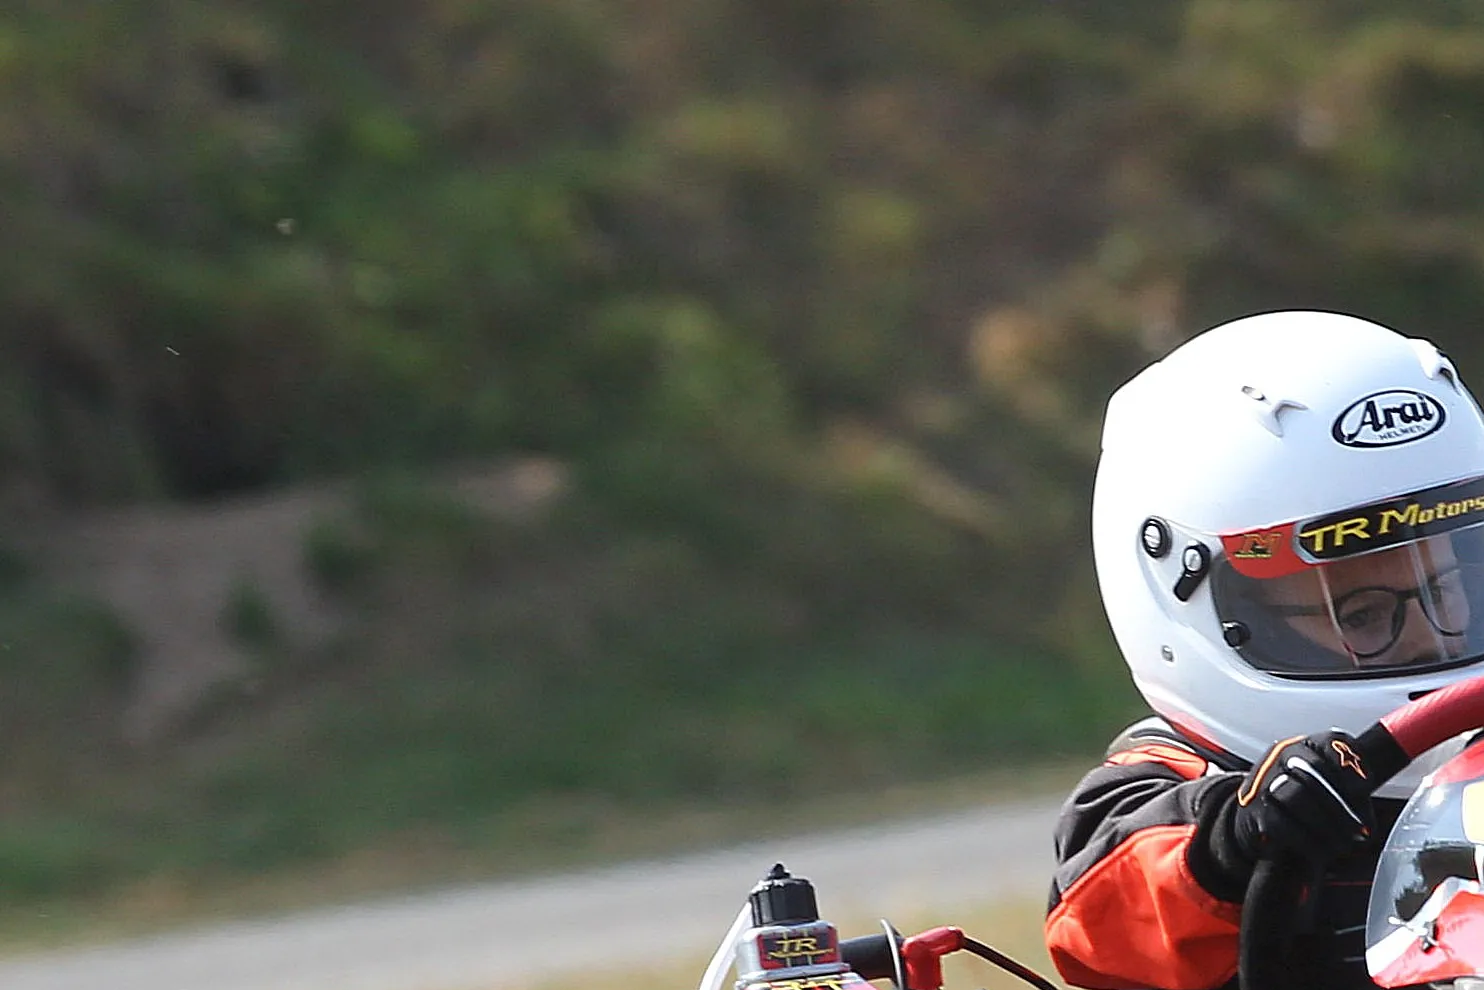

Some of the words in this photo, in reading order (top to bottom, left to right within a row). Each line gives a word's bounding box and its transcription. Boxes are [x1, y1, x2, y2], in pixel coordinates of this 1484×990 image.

[1346, 393, 1433, 441] Arai
[1299, 517, 1371, 552] TR
[776, 938, 817, 953] TR
